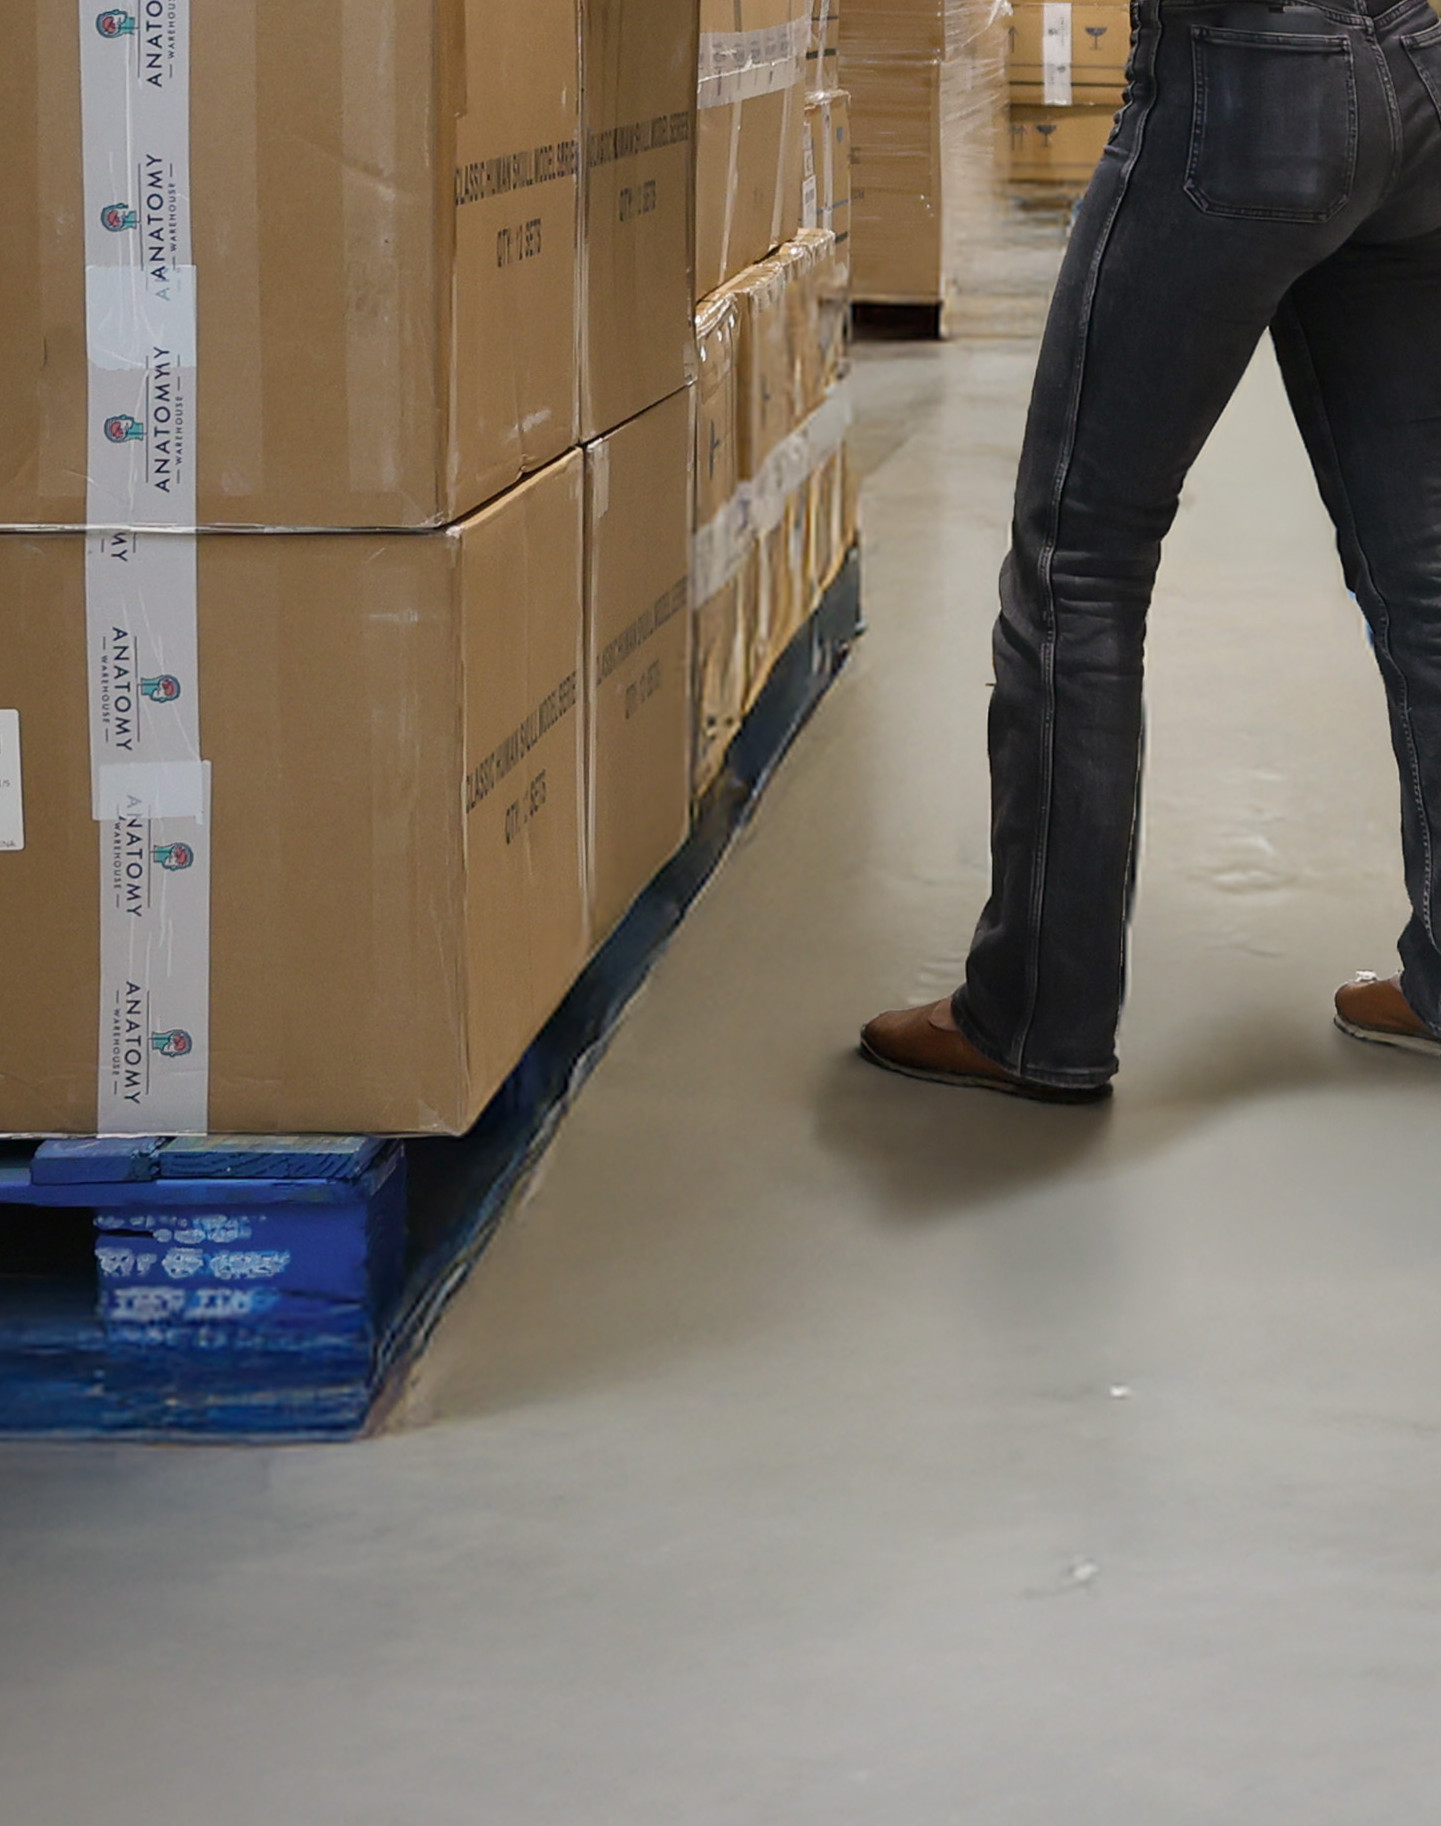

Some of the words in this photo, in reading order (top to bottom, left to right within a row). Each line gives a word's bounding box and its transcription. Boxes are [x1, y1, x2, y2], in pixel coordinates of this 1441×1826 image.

[146, 153, 166, 281] ANATOMY
[168, 182, 176, 253] WAREHOUSE
[176, 395, 184, 465] WAREHOUSE
[101, 653, 110, 724] WAREHOUSE
[111, 625, 133, 752] ANATOMY
[111, 821, 121, 890] WAREHOUSE
[111, 1007, 120, 1076] WAREHOUSE
[123, 981, 141, 1105] ANATOMY
